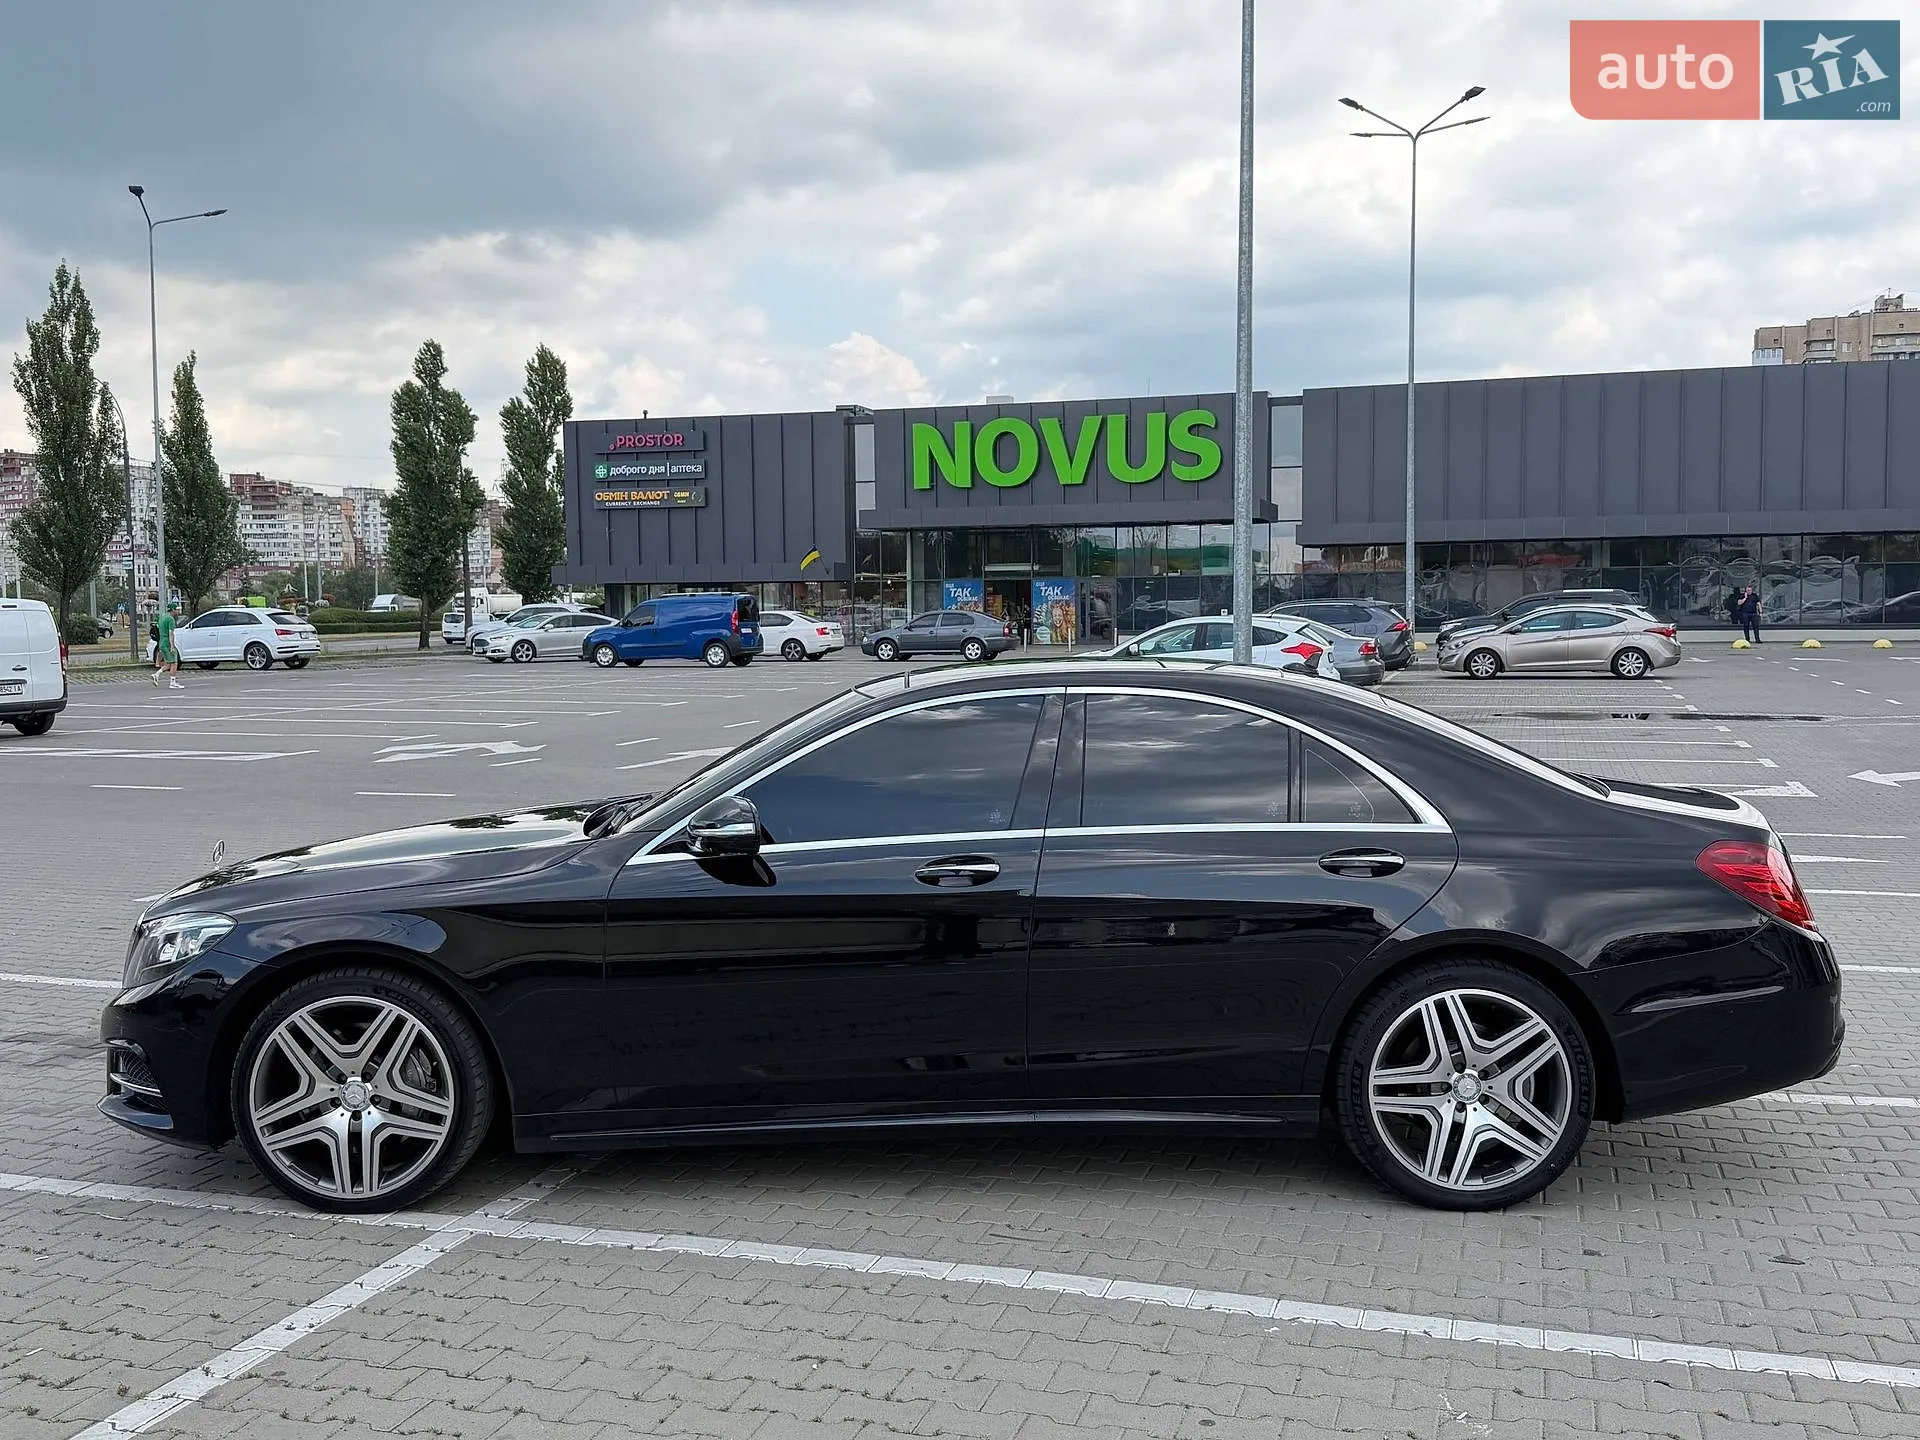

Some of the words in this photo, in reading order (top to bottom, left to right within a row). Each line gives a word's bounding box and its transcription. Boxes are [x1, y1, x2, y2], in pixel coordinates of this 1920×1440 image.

[615, 433, 684, 448] PROSTOR
[912, 409, 1222, 490] NOVUS
[610, 465, 647, 477] доброго
[649, 465, 665, 475] дня
[670, 464, 702, 473] аптека
[595, 491, 628, 501] ОБМІН
[631, 490, 670, 500] ВАЛЮТ
[950, 587, 971, 597] ТАК
[1040, 586, 1062, 596] ТАК
[1568, 1032, 1591, 1116] MICHELIN
[1354, 1061, 1376, 1147] MICHELIN
